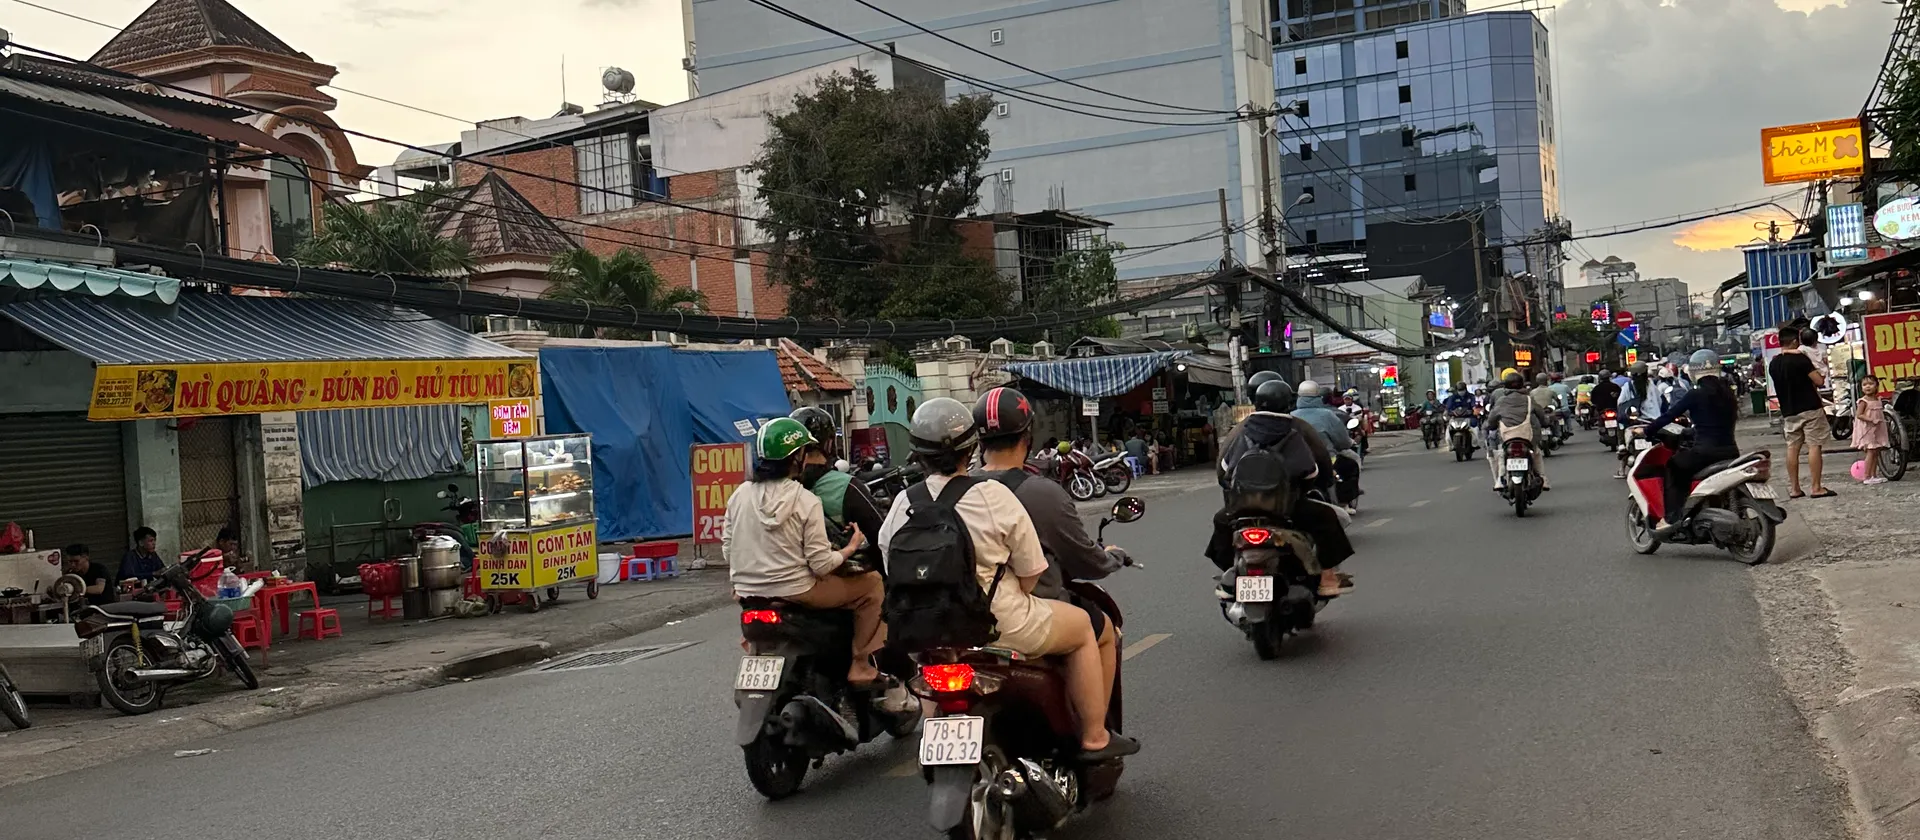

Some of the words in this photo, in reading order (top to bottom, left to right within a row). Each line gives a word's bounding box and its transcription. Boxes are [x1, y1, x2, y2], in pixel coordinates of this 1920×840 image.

[1814, 136, 1828, 153] M
[1800, 155, 1829, 166] CAFE
[178, 373, 212, 409] MÌ
[215, 368, 304, 413] QUẢNG
[320, 369, 371, 403] BÚN
[371, 370, 400, 400] BÒ
[414, 366, 444, 399] HỦ
[448, 368, 480, 398] TÍU
[483, 368, 505, 396] MÌ
[511, 401, 530, 419] TẤM
[783, 430, 803, 444] Grab
[693, 447, 744, 473] CƠM
[537, 534, 565, 555] CƠM
[567, 526, 593, 549] TẤM
[491, 572, 520, 585] 25K
[557, 565, 577, 581] 25K
[932, 720, 973, 741] 78-C1
[925, 741, 978, 761] 602.32
